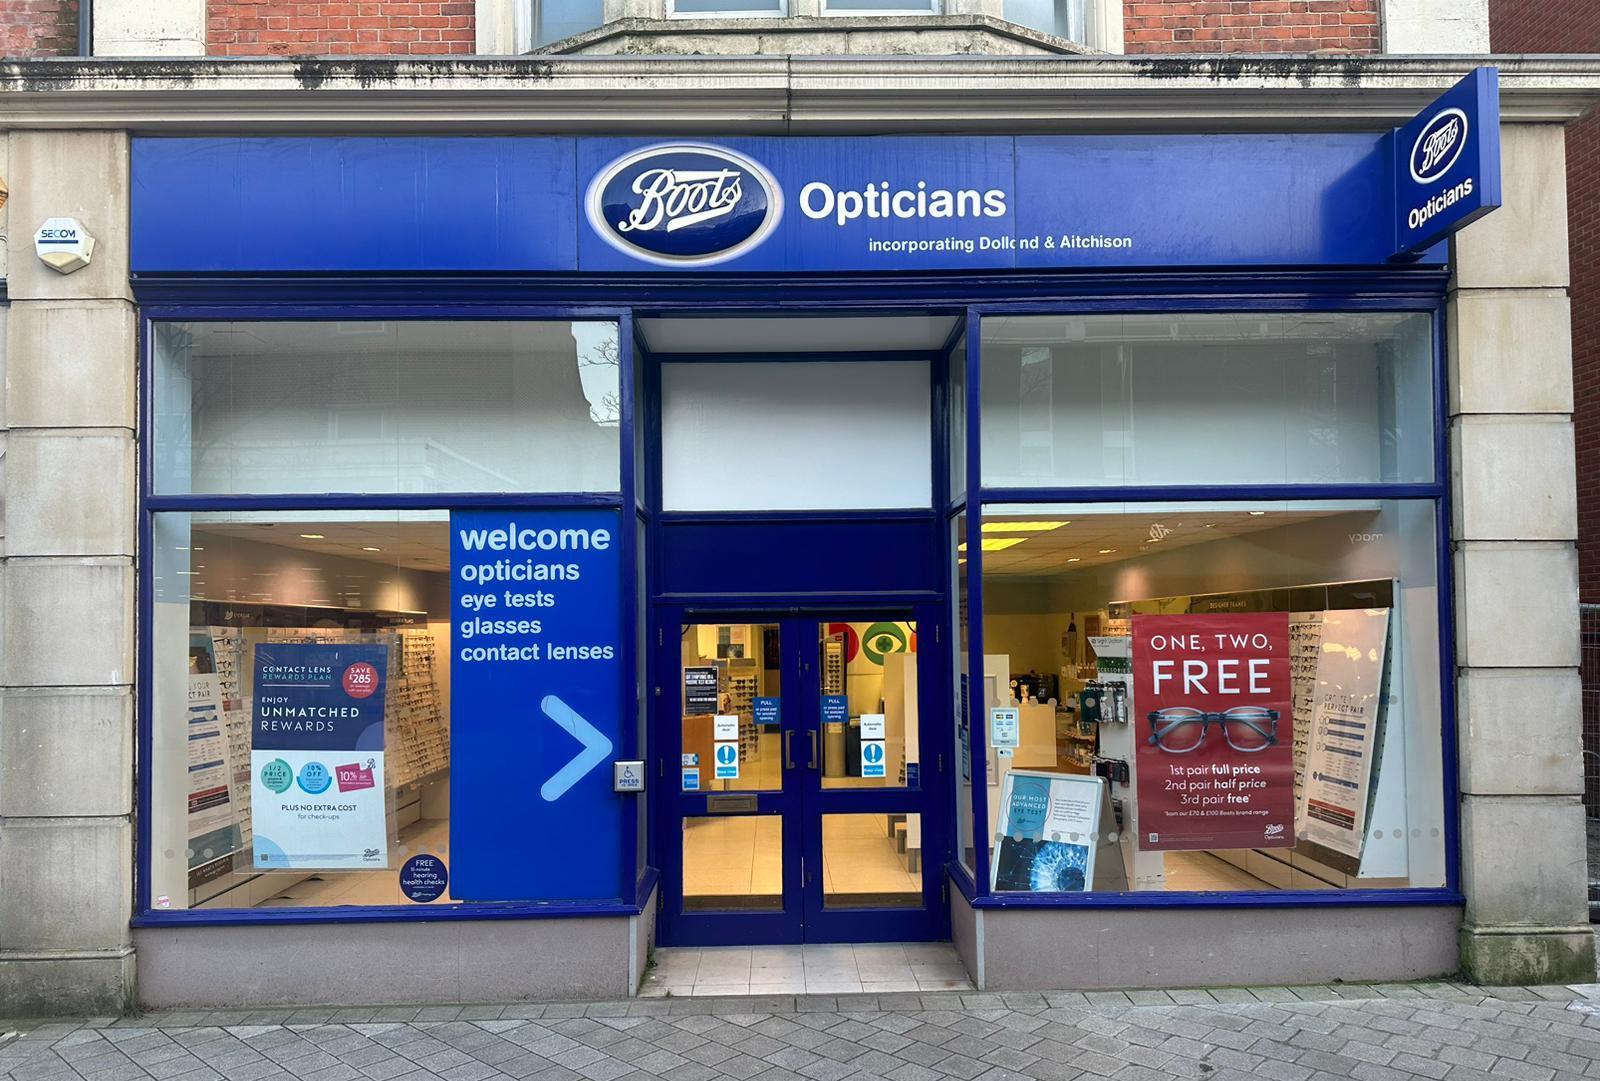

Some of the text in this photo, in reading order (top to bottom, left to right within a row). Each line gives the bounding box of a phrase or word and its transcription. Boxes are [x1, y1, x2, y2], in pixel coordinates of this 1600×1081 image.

[1418, 116, 1459, 175] Boots
[618, 167, 744, 233] Boots
[799, 180, 1007, 226] Opticians
[1408, 177, 1473, 229] Opticians
[41, 229, 76, 238] SECOM
[869, 237, 974, 253] incorporating
[1044, 236, 1055, 249] &
[1060, 235, 1132, 249] Aitchison
[459, 522, 611, 551] welcome
[460, 558, 581, 586] opticians
[460, 590, 555, 611] eye tests
[460, 616, 542, 639] glasses
[1151, 633, 1273, 652] ONE, TWO,
[460, 642, 614, 661] contact lenses
[308, 673, 332, 681] PLAN
[348, 674, 371, 684] £285
[1152, 659, 1271, 695] FREE
[261, 706, 360, 718] UNMATCHED
[261, 720, 334, 732] REWARDS
[339, 771, 357, 782] 10%
[1169, 764, 1261, 777] 1st pair full price
[1164, 778, 1267, 792] 2nd pair half price
[1012, 801, 1047, 809] ADVANCED
[1180, 793, 1199, 805] 3rd
[1202, 794, 1225, 806] pair
[308, 813, 340, 821] check-ups
[413, 872, 438, 880] hearing
